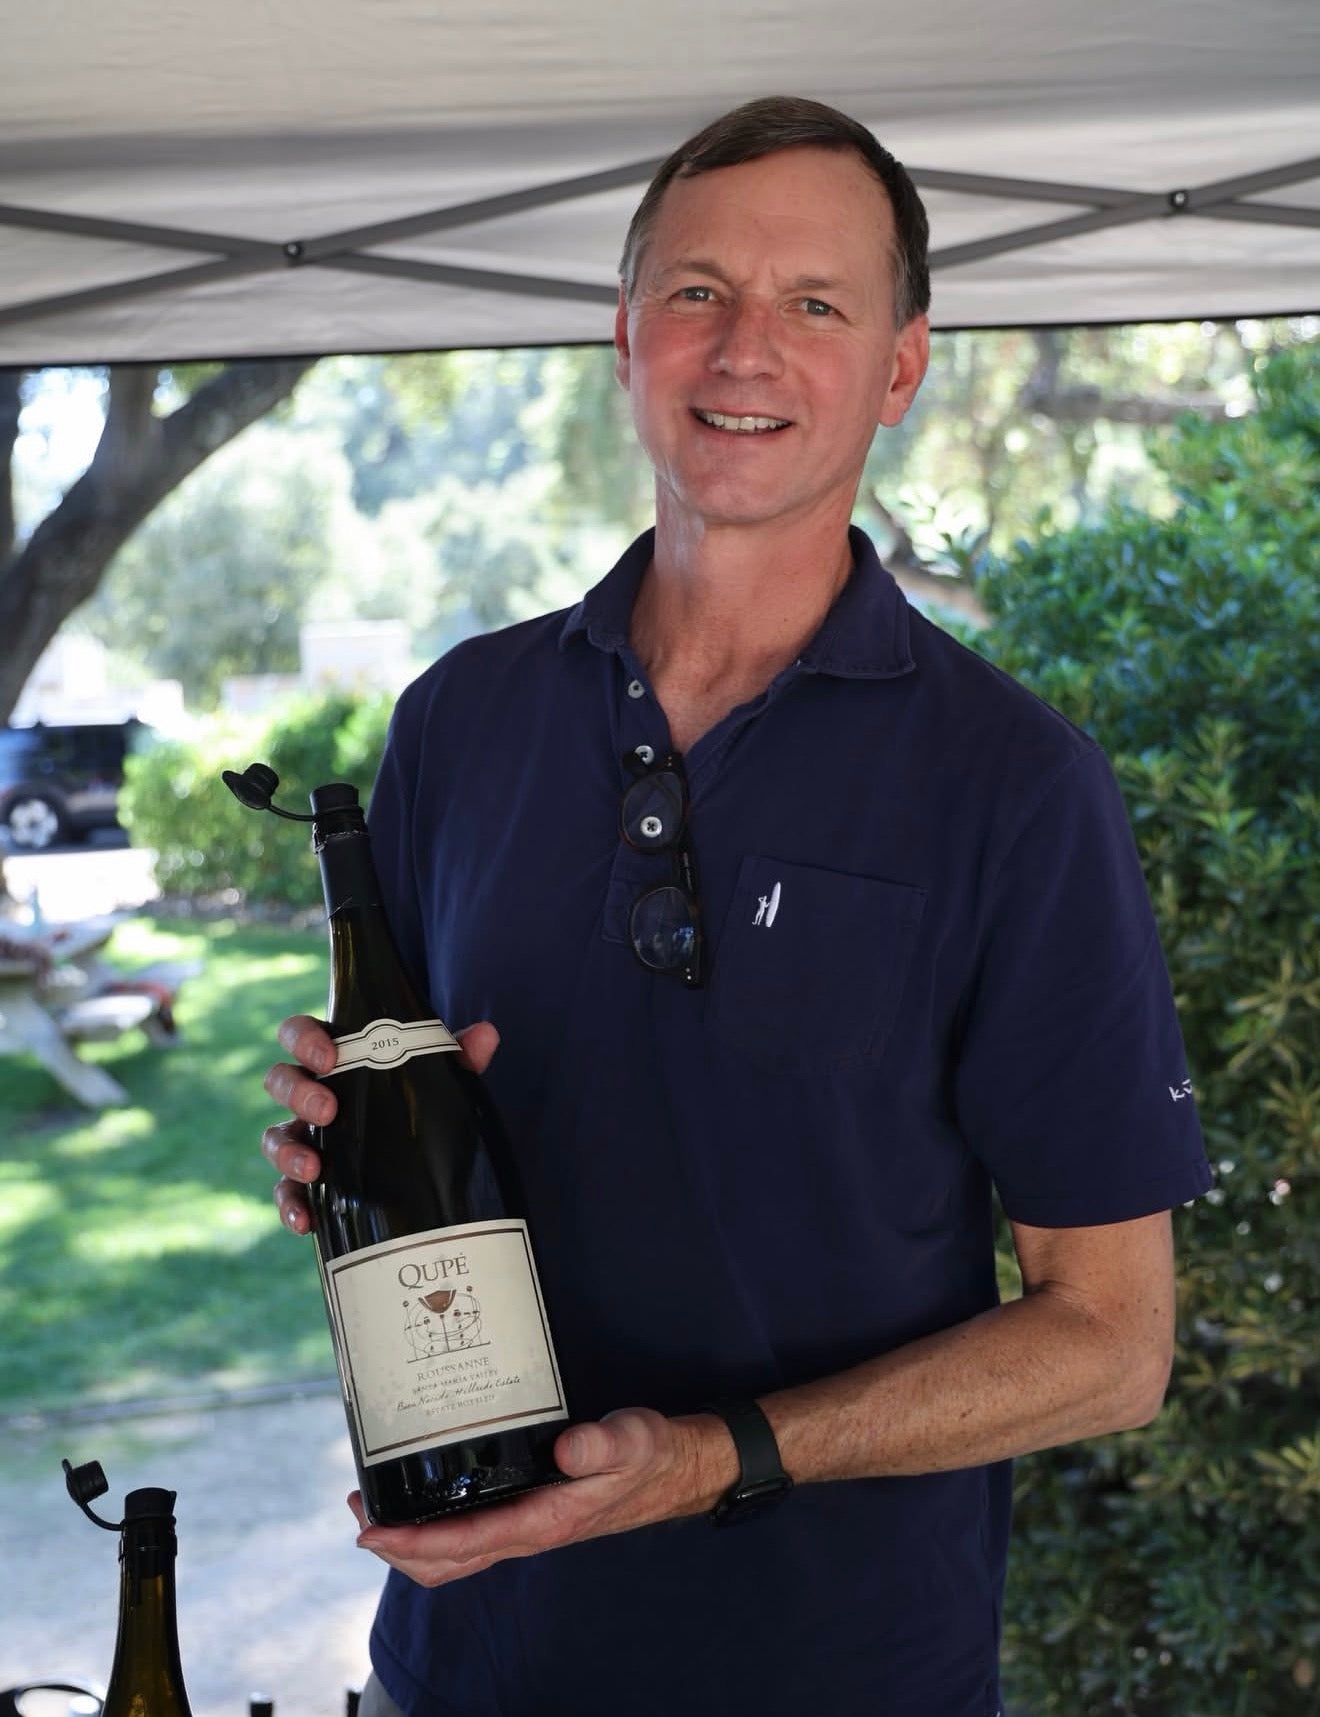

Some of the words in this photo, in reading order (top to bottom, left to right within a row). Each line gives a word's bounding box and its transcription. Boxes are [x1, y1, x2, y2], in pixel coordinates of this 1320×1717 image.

[371, 1037, 399, 1051] 2015
[416, 1356, 489, 1382] ROUSSANNE
[495, 1375, 520, 1388] Estate
